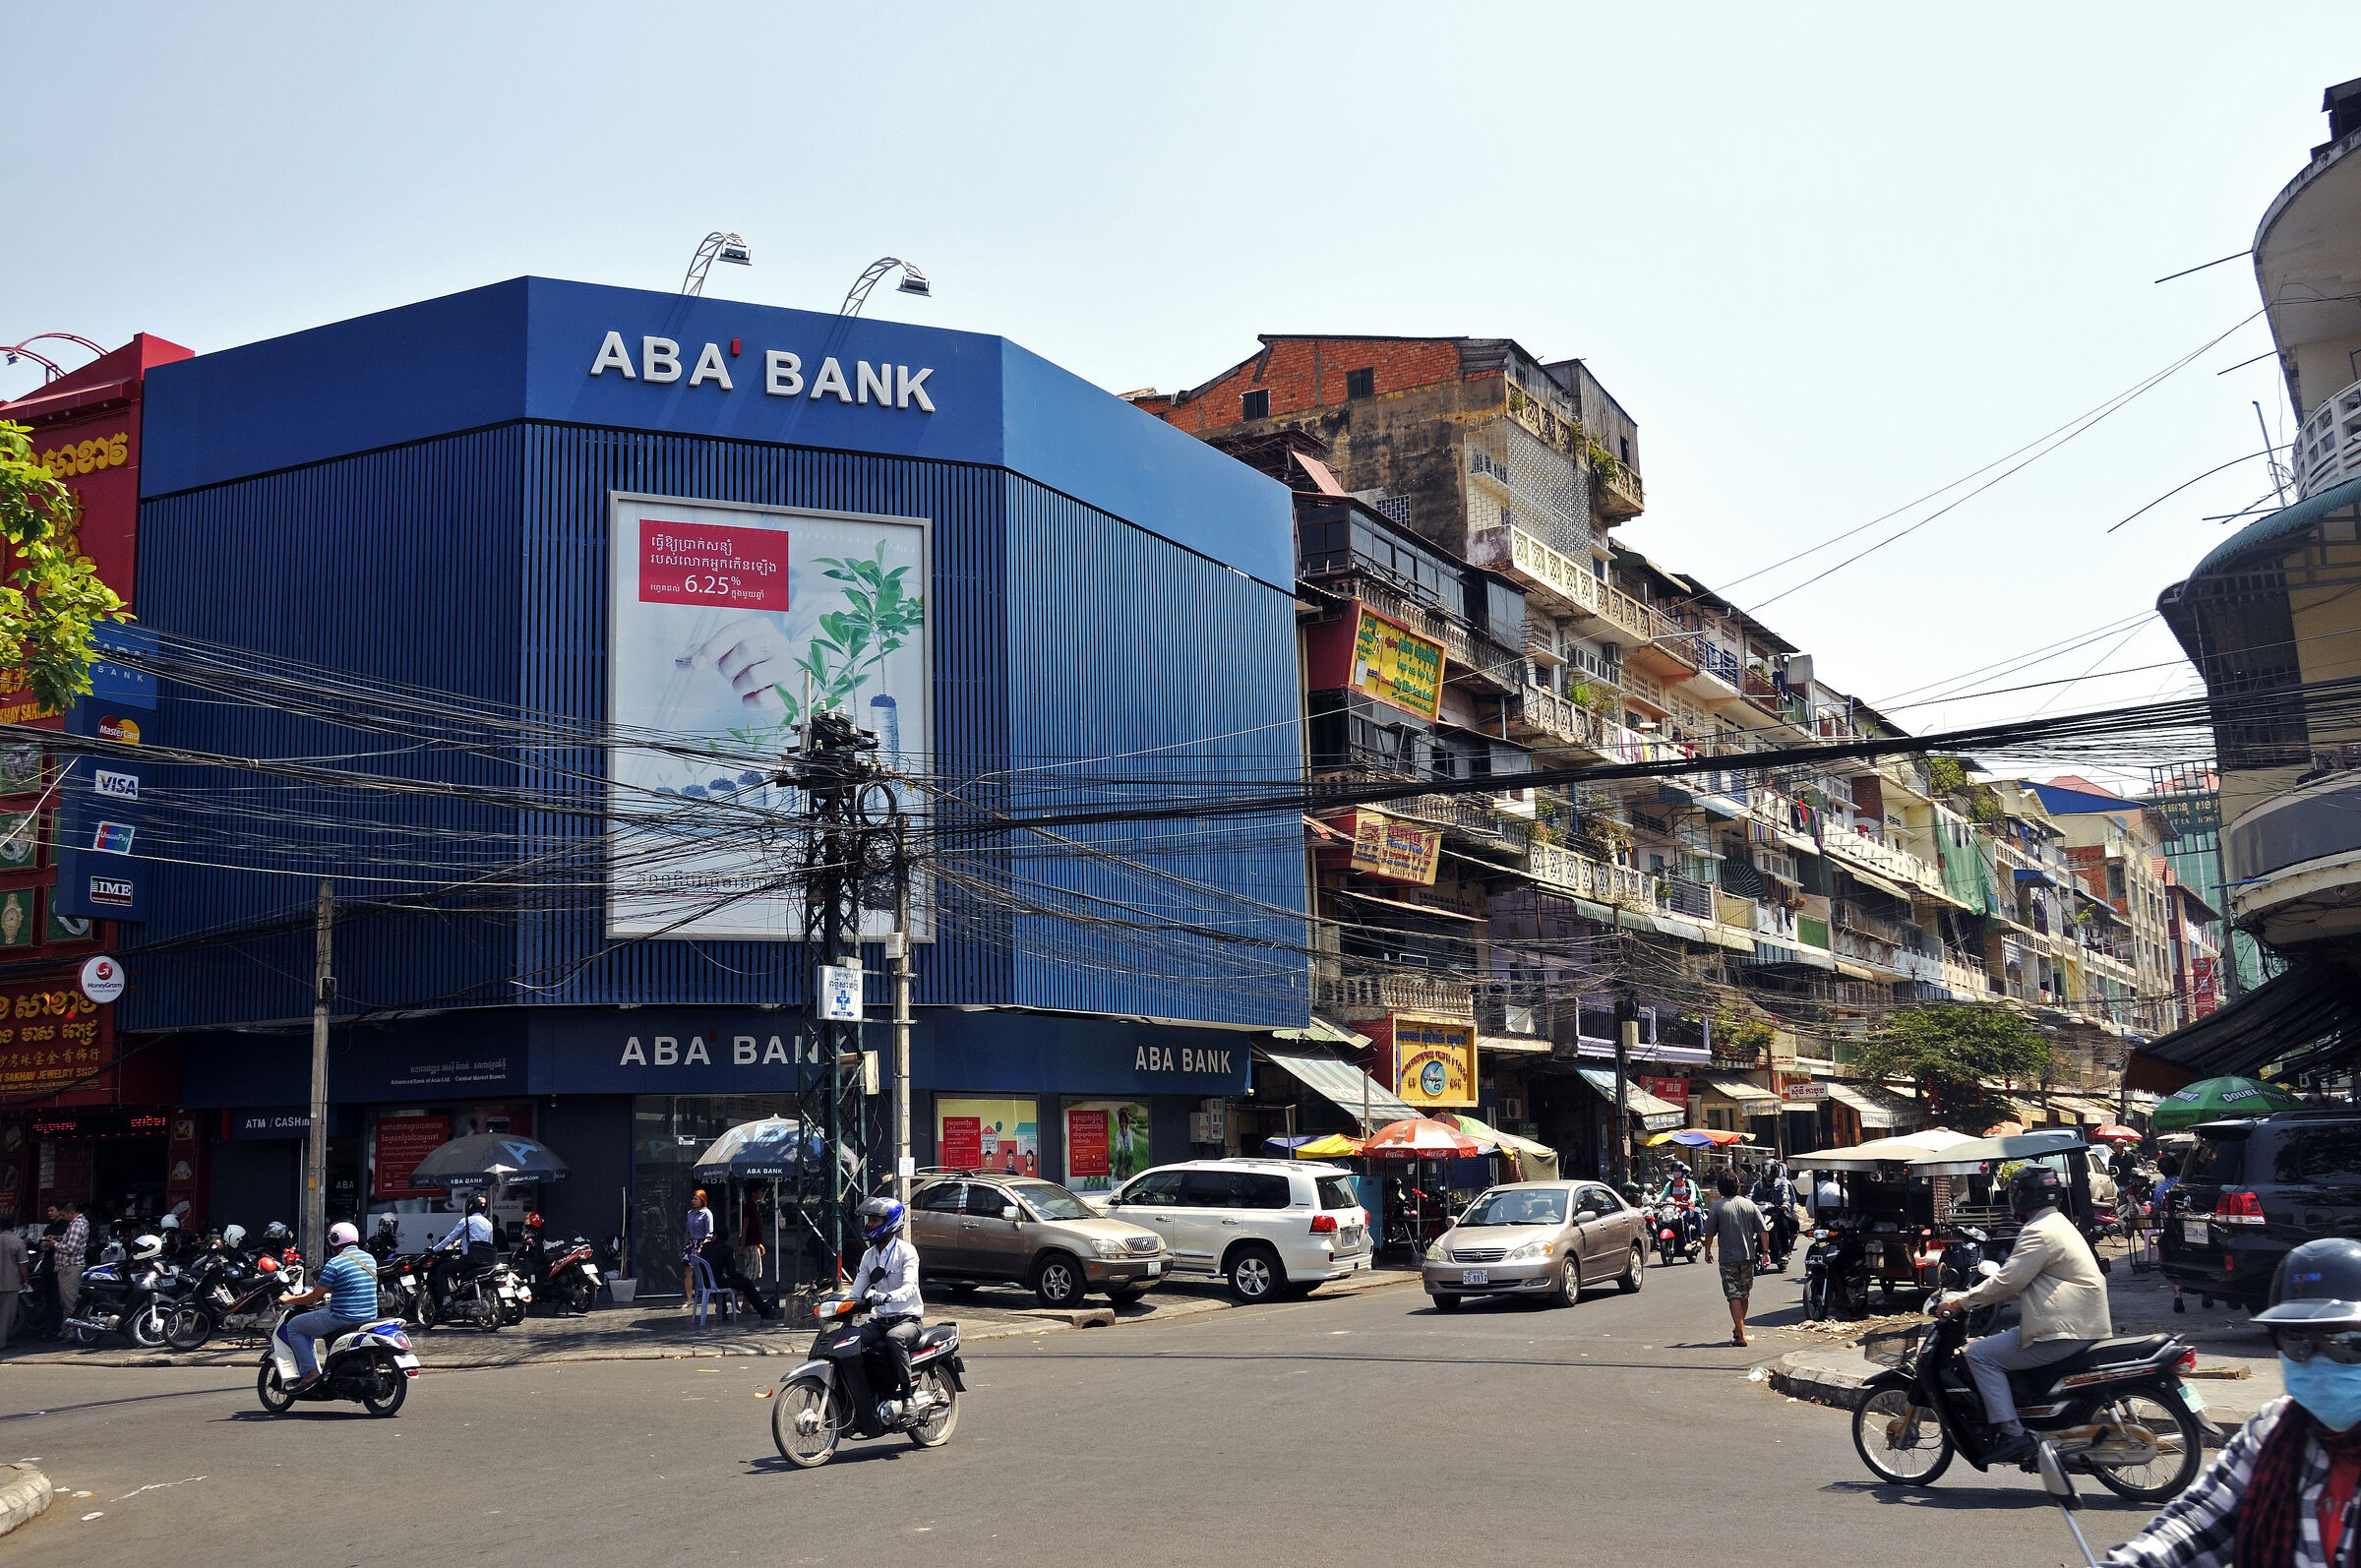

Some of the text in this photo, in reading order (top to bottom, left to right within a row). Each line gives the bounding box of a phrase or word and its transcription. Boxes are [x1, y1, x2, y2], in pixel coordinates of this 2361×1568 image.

[590, 331, 936, 412] ABA BANK
[98, 665, 144, 683] BANK
[99, 725, 140, 741] MasterCard
[100, 776, 138, 797] VISA
[100, 831, 130, 845] UnionPay
[99, 881, 132, 896] IME
[620, 1035, 711, 1066] ABA
[1135, 1046, 1232, 1074] ABA BANK
[37, 1068, 74, 1080] JEWELRY
[246, 1118, 266, 1128] ATM
